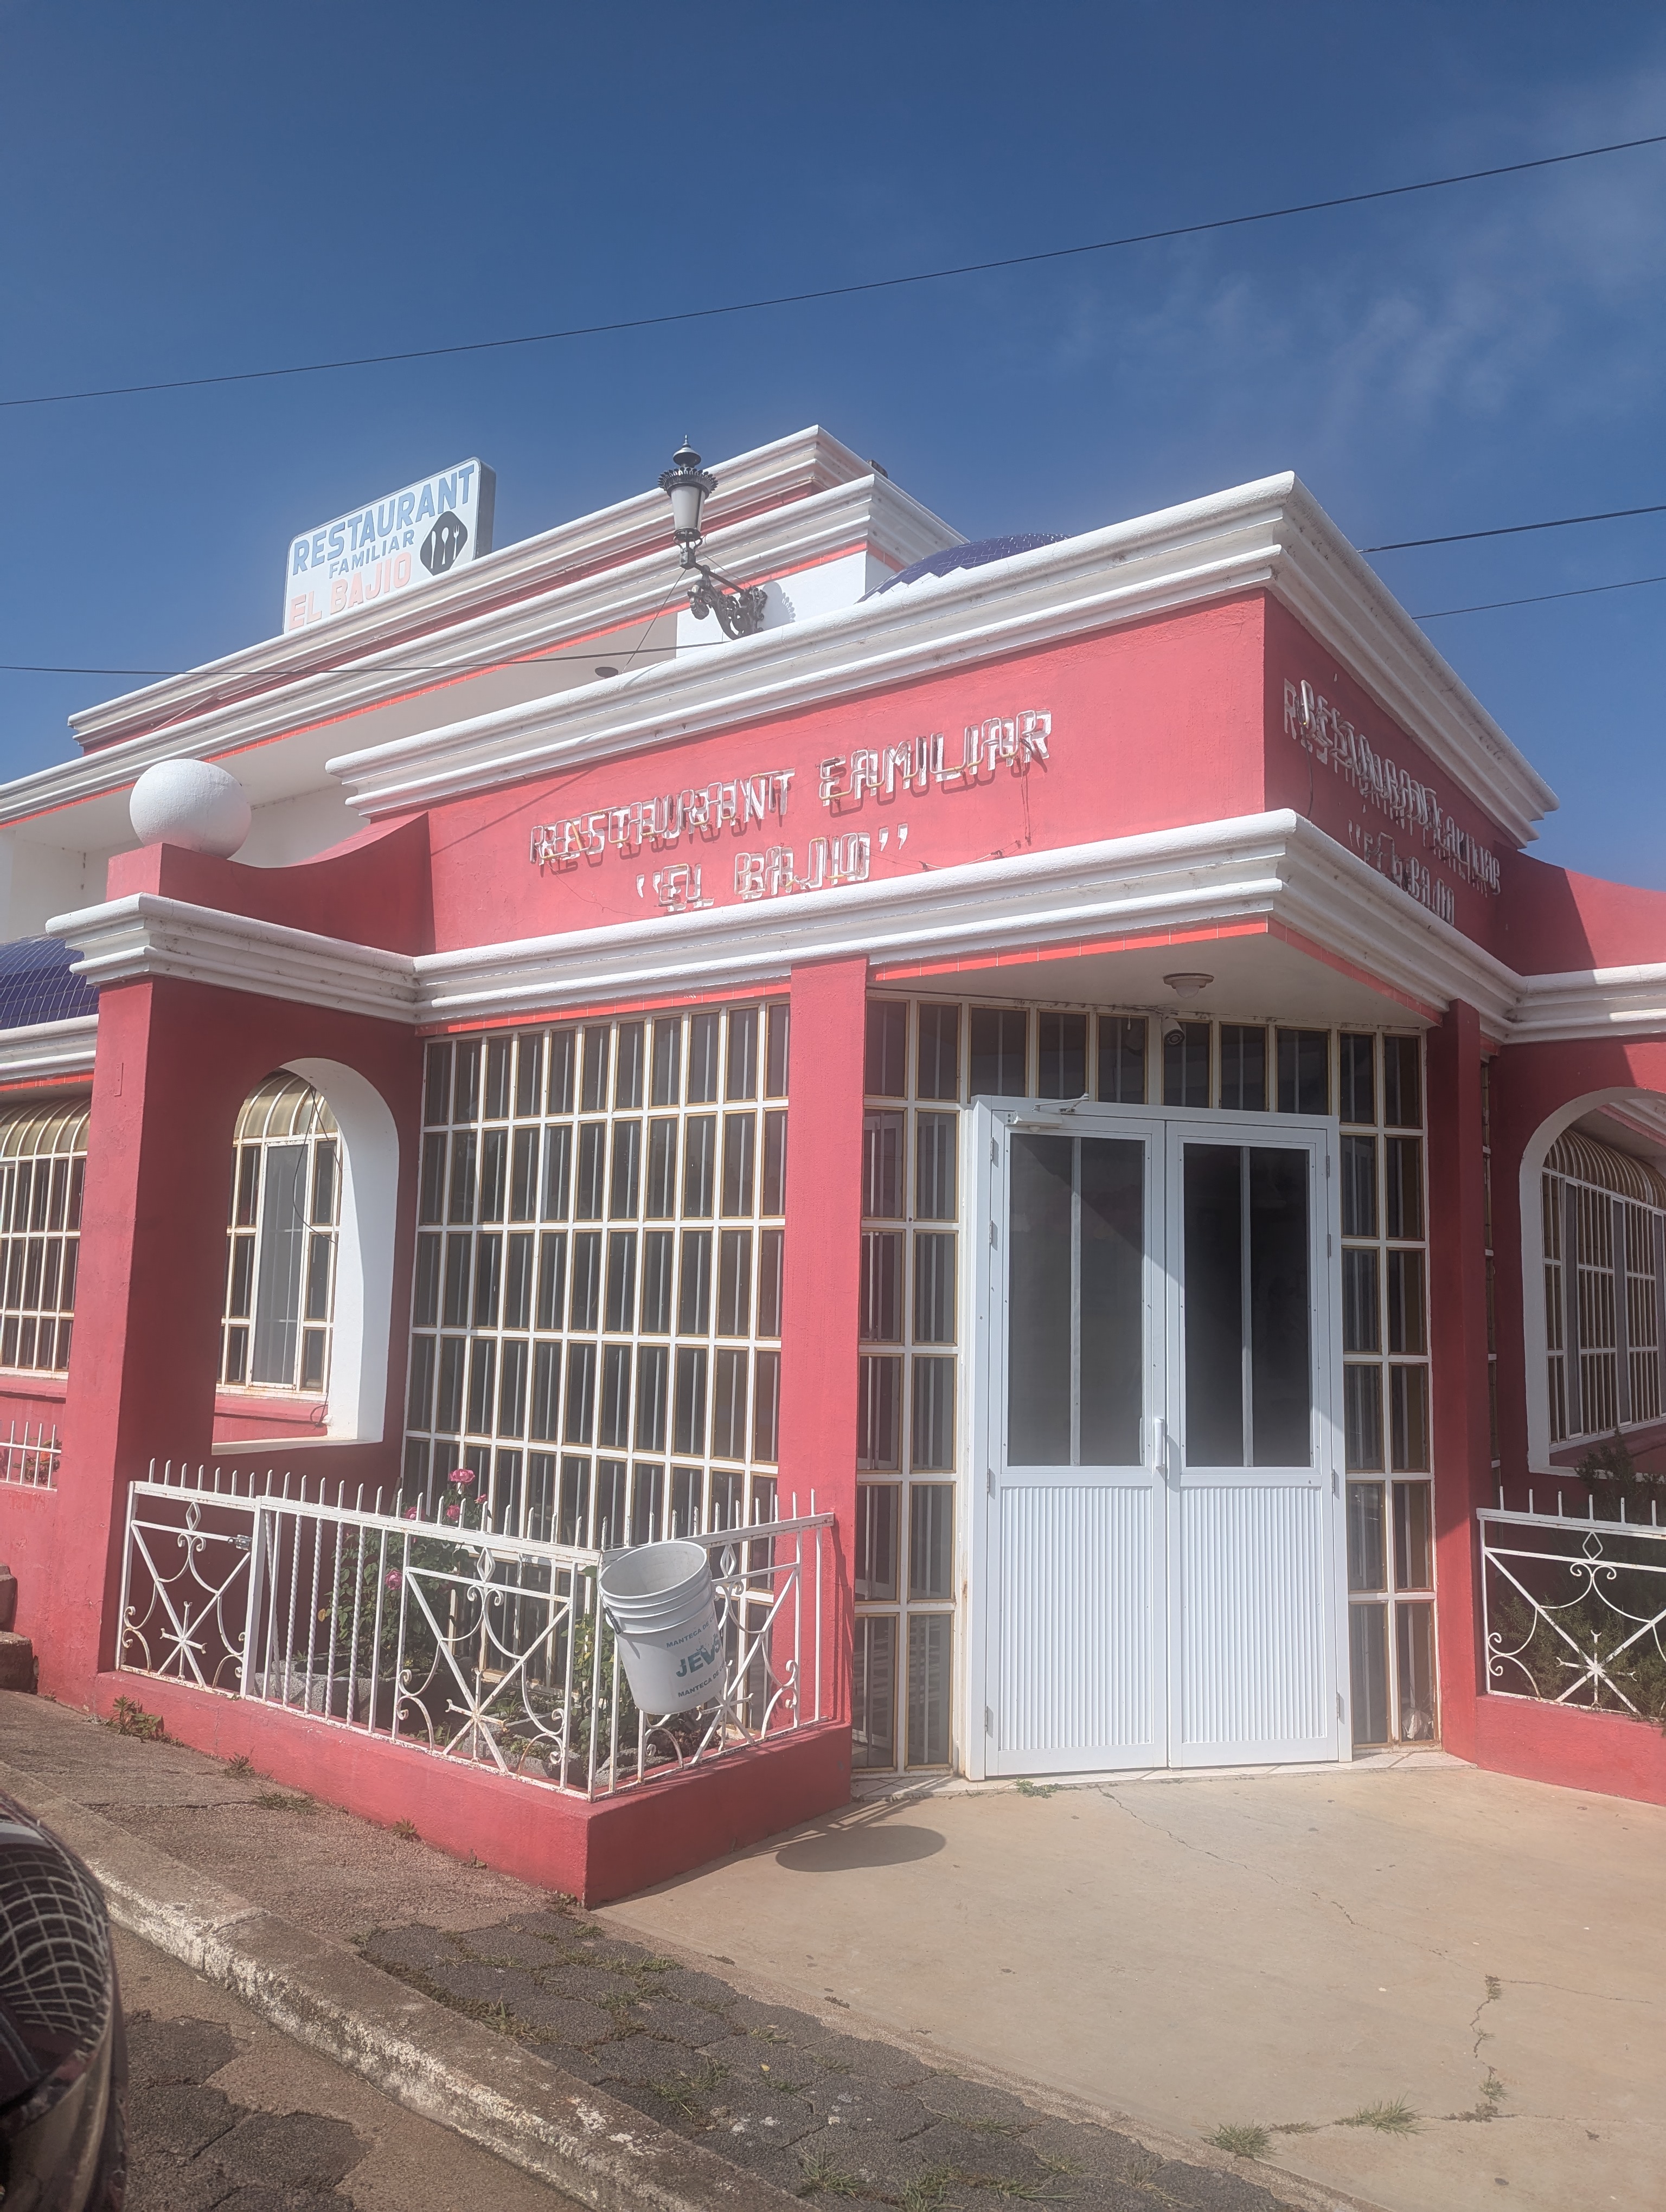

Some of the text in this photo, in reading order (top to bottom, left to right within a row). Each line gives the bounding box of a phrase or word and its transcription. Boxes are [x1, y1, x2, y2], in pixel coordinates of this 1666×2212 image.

[292, 464, 475, 576] RESTAURANT
[329, 529, 415, 578] FAMILIAR
[289, 551, 412, 631] EL BAJIO
[530, 709, 1052, 866] RESTAURANT FAMILIAR
[666, 1621, 709, 1648] MANTECA DE
[678, 1670, 719, 1697] MANTECA DE
